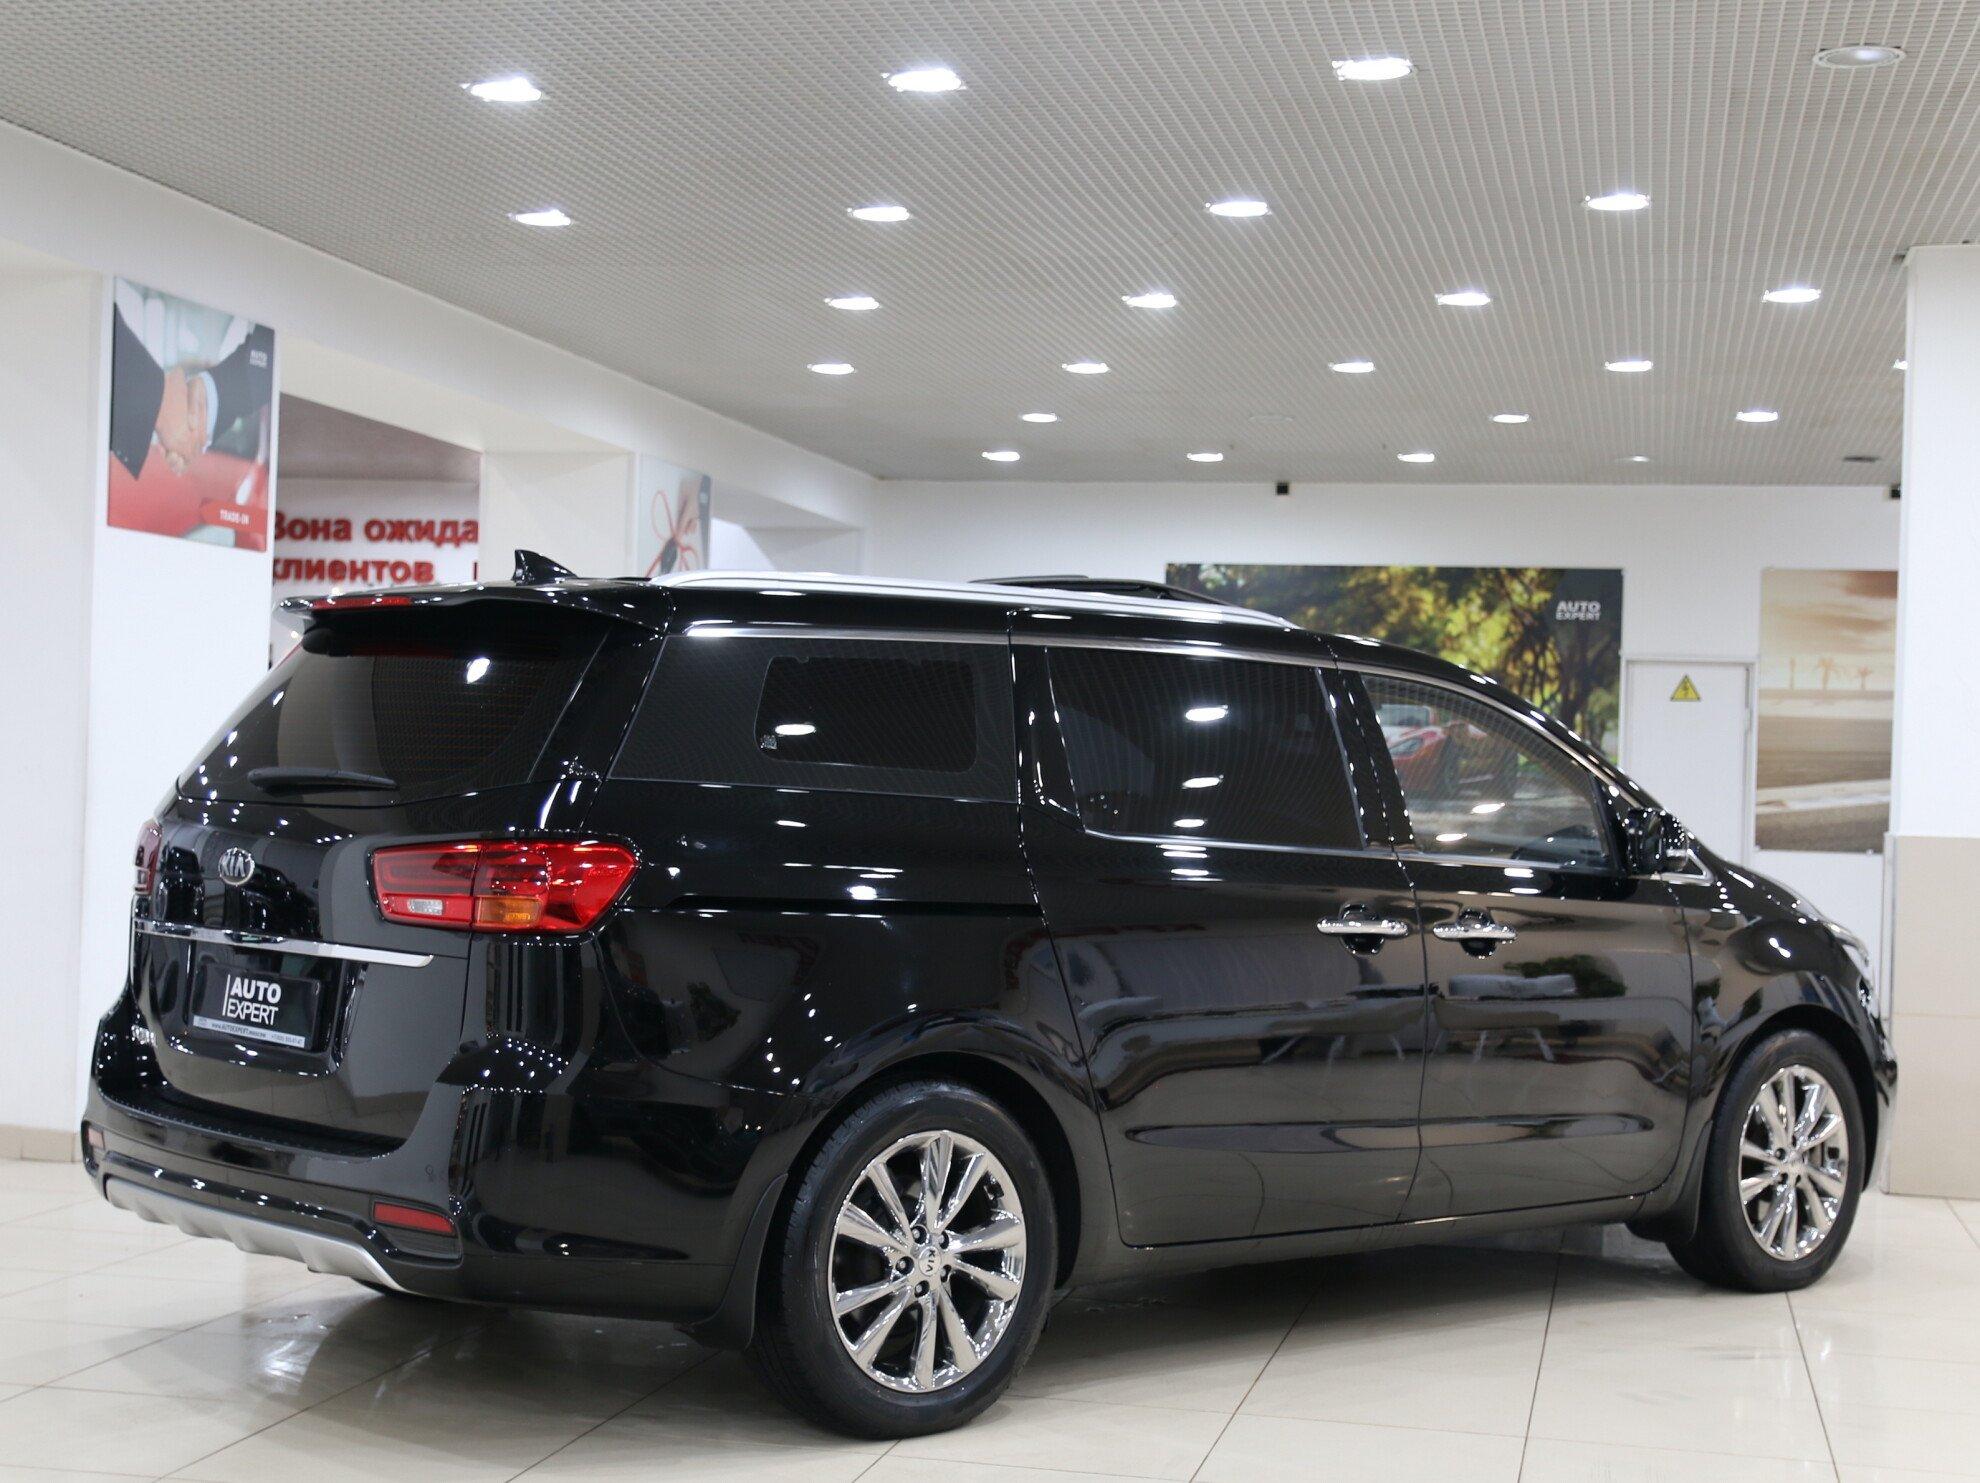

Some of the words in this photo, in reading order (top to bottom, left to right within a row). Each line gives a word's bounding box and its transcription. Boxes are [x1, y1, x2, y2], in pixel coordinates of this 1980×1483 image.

[1556, 600, 1601, 612] AUTO
[221, 852, 246, 877] KIA
[230, 976, 282, 1004] AUTO
[226, 998, 279, 1026] EXPERT
